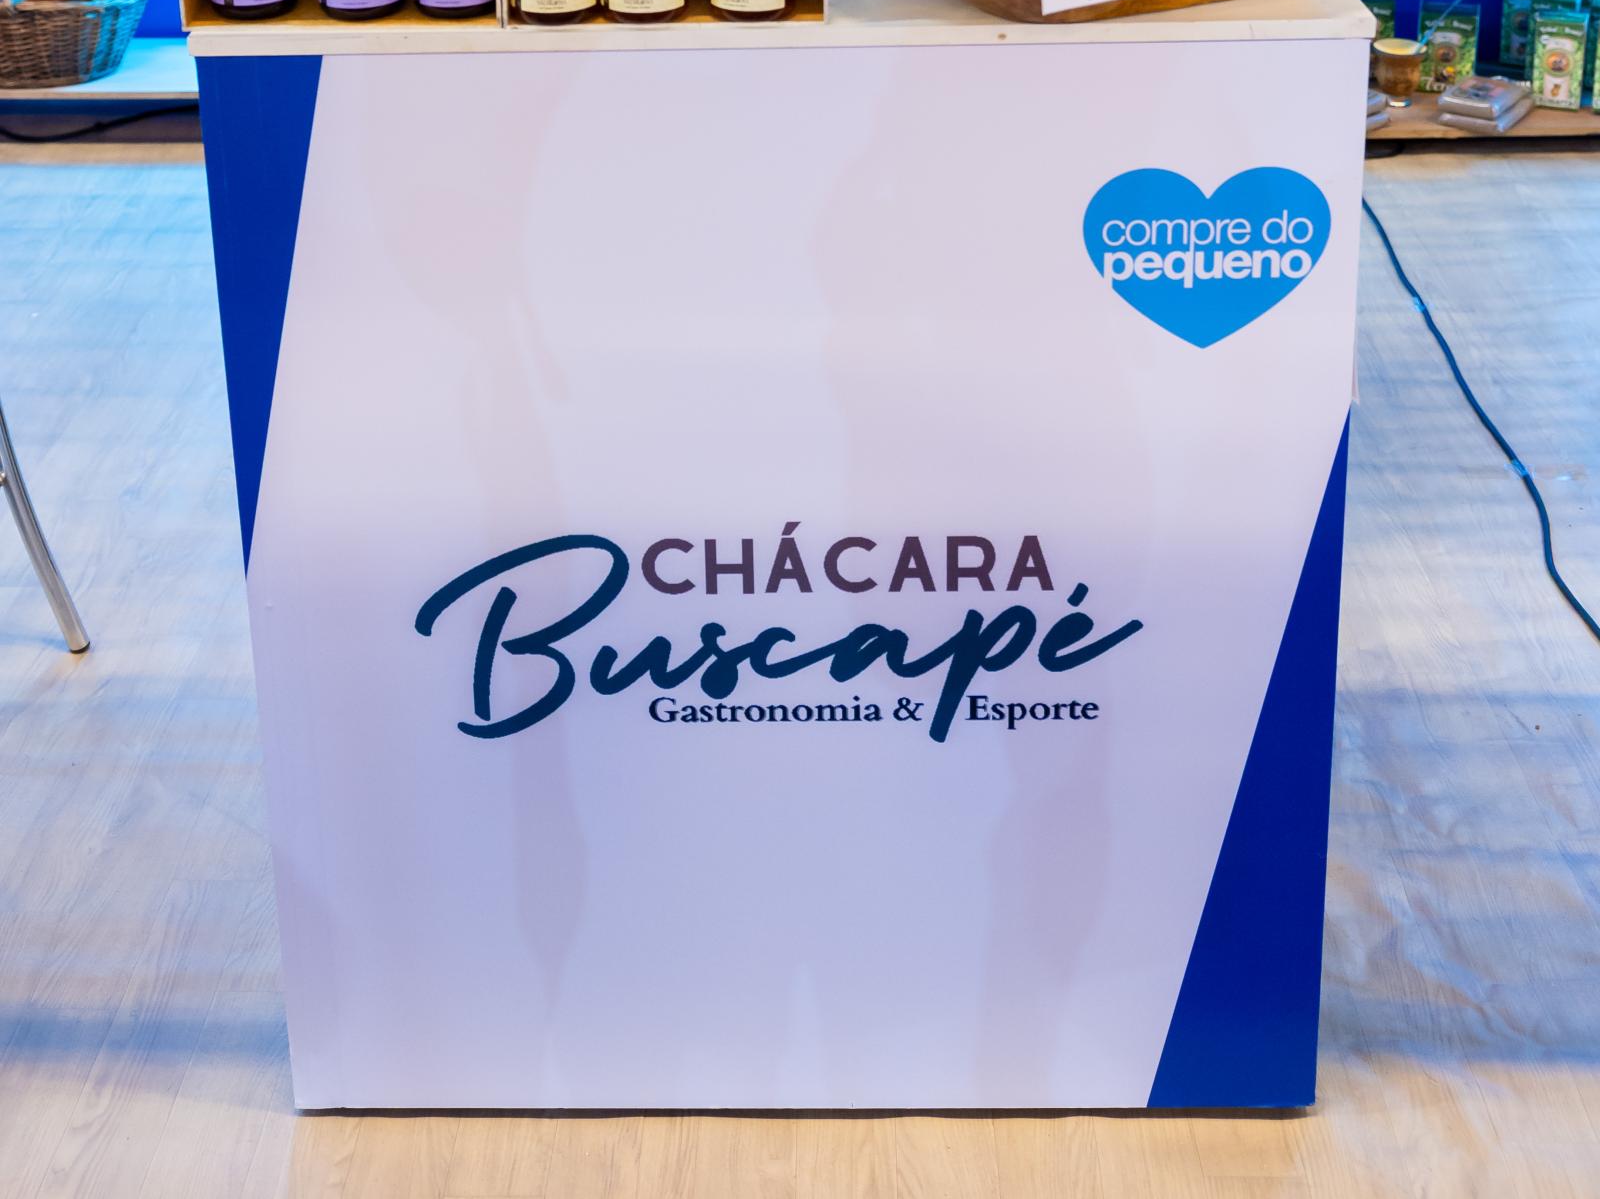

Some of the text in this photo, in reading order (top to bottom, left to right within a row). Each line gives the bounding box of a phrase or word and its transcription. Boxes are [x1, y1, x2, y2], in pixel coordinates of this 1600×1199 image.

[1101, 209, 1315, 250] compre do
[1103, 248, 1313, 289] pequeno
[640, 521, 1056, 596] CHÁCARA
[414, 533, 1145, 743] Buscapé
[647, 695, 1101, 731] Gastronomia & Esporte
